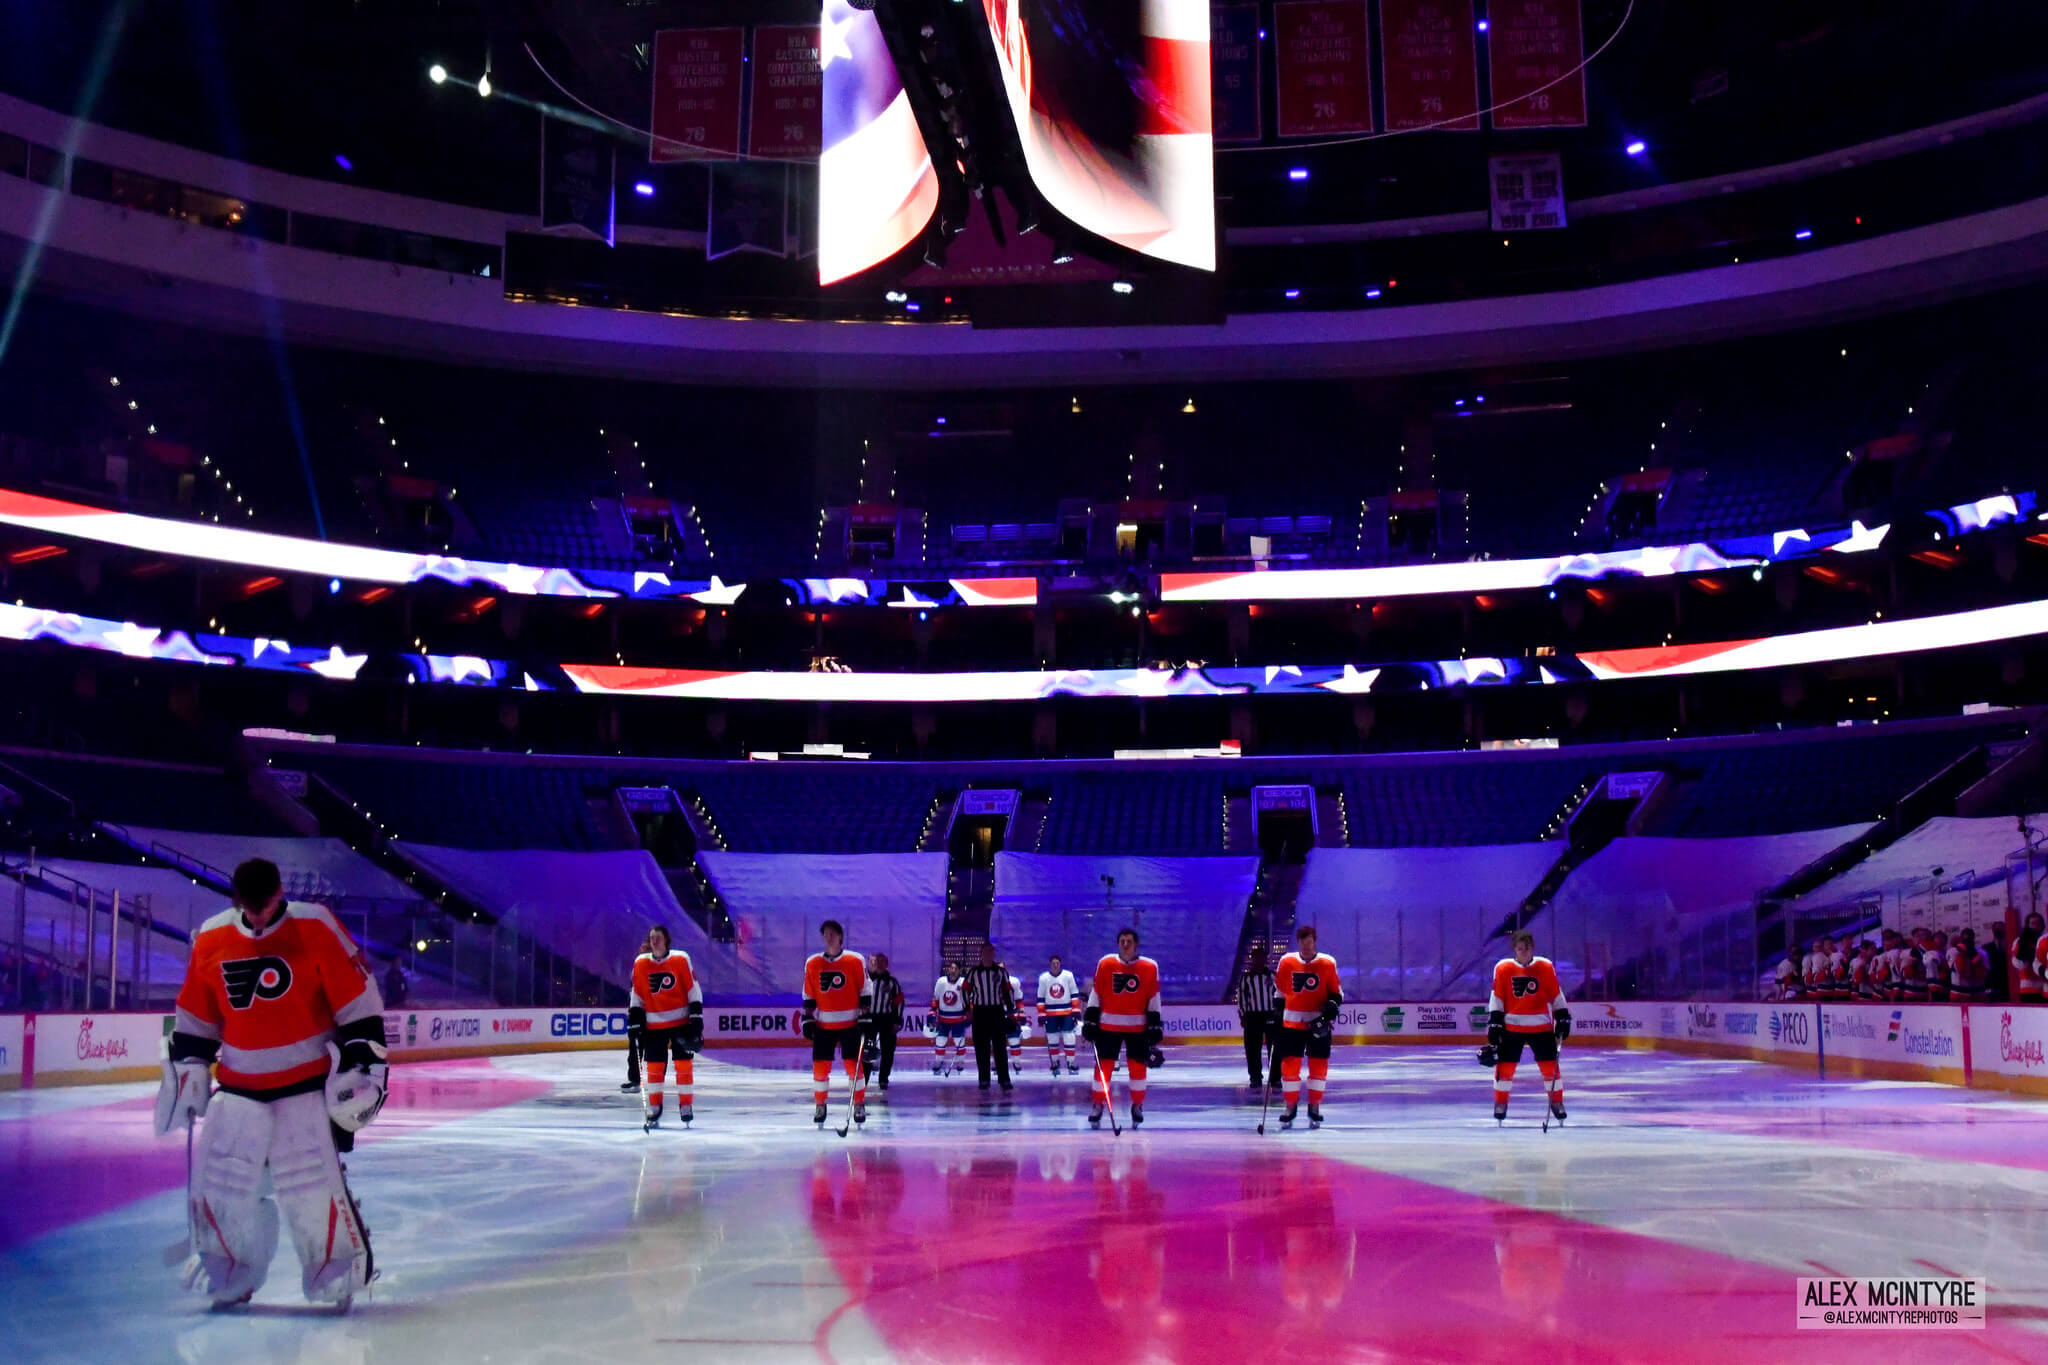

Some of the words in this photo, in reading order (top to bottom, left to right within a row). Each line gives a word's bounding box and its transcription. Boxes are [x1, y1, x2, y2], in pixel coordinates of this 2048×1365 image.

[551, 1013, 628, 1036] GEICO
[718, 1015, 787, 1031] BELFOR
[1161, 1017, 1232, 1032] nstellation
[1782, 1012, 1808, 1045] PECO
[1904, 1027, 1953, 1057] Constellation
